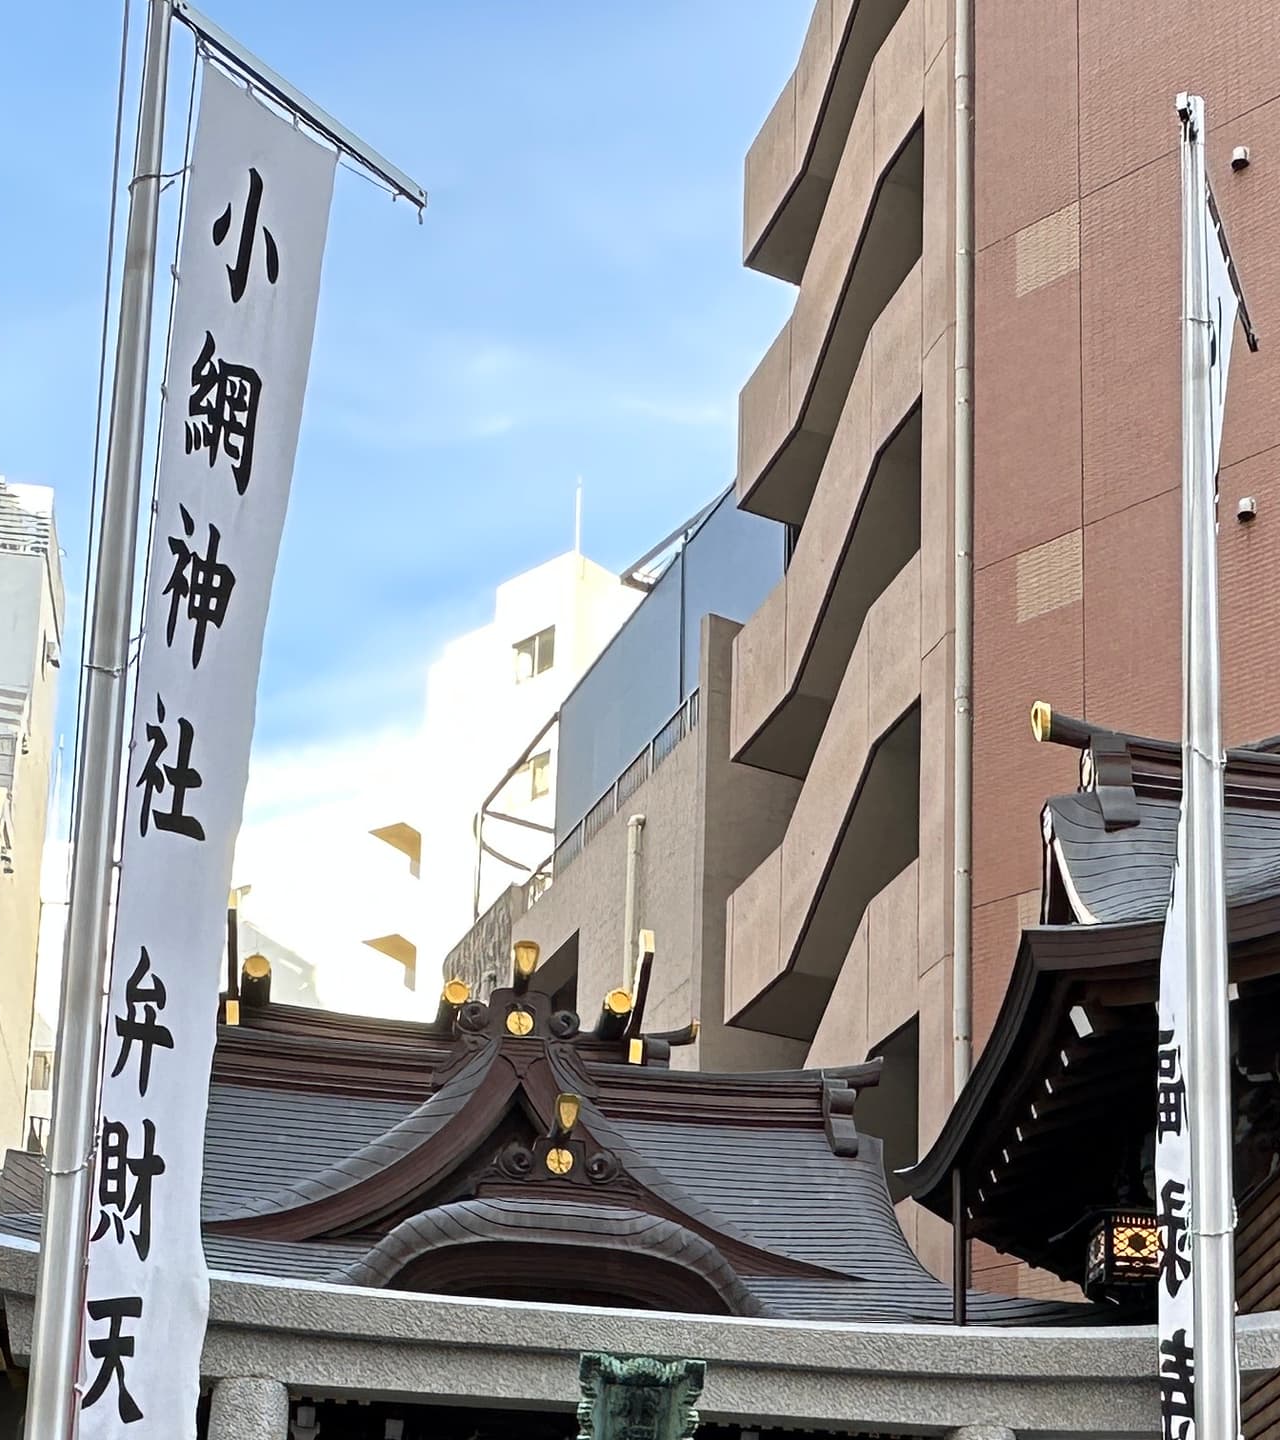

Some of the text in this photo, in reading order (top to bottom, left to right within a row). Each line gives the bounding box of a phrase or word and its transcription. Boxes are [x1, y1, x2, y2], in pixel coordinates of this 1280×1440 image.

[81, 167, 280, 1424] 小網神社 弁財天
